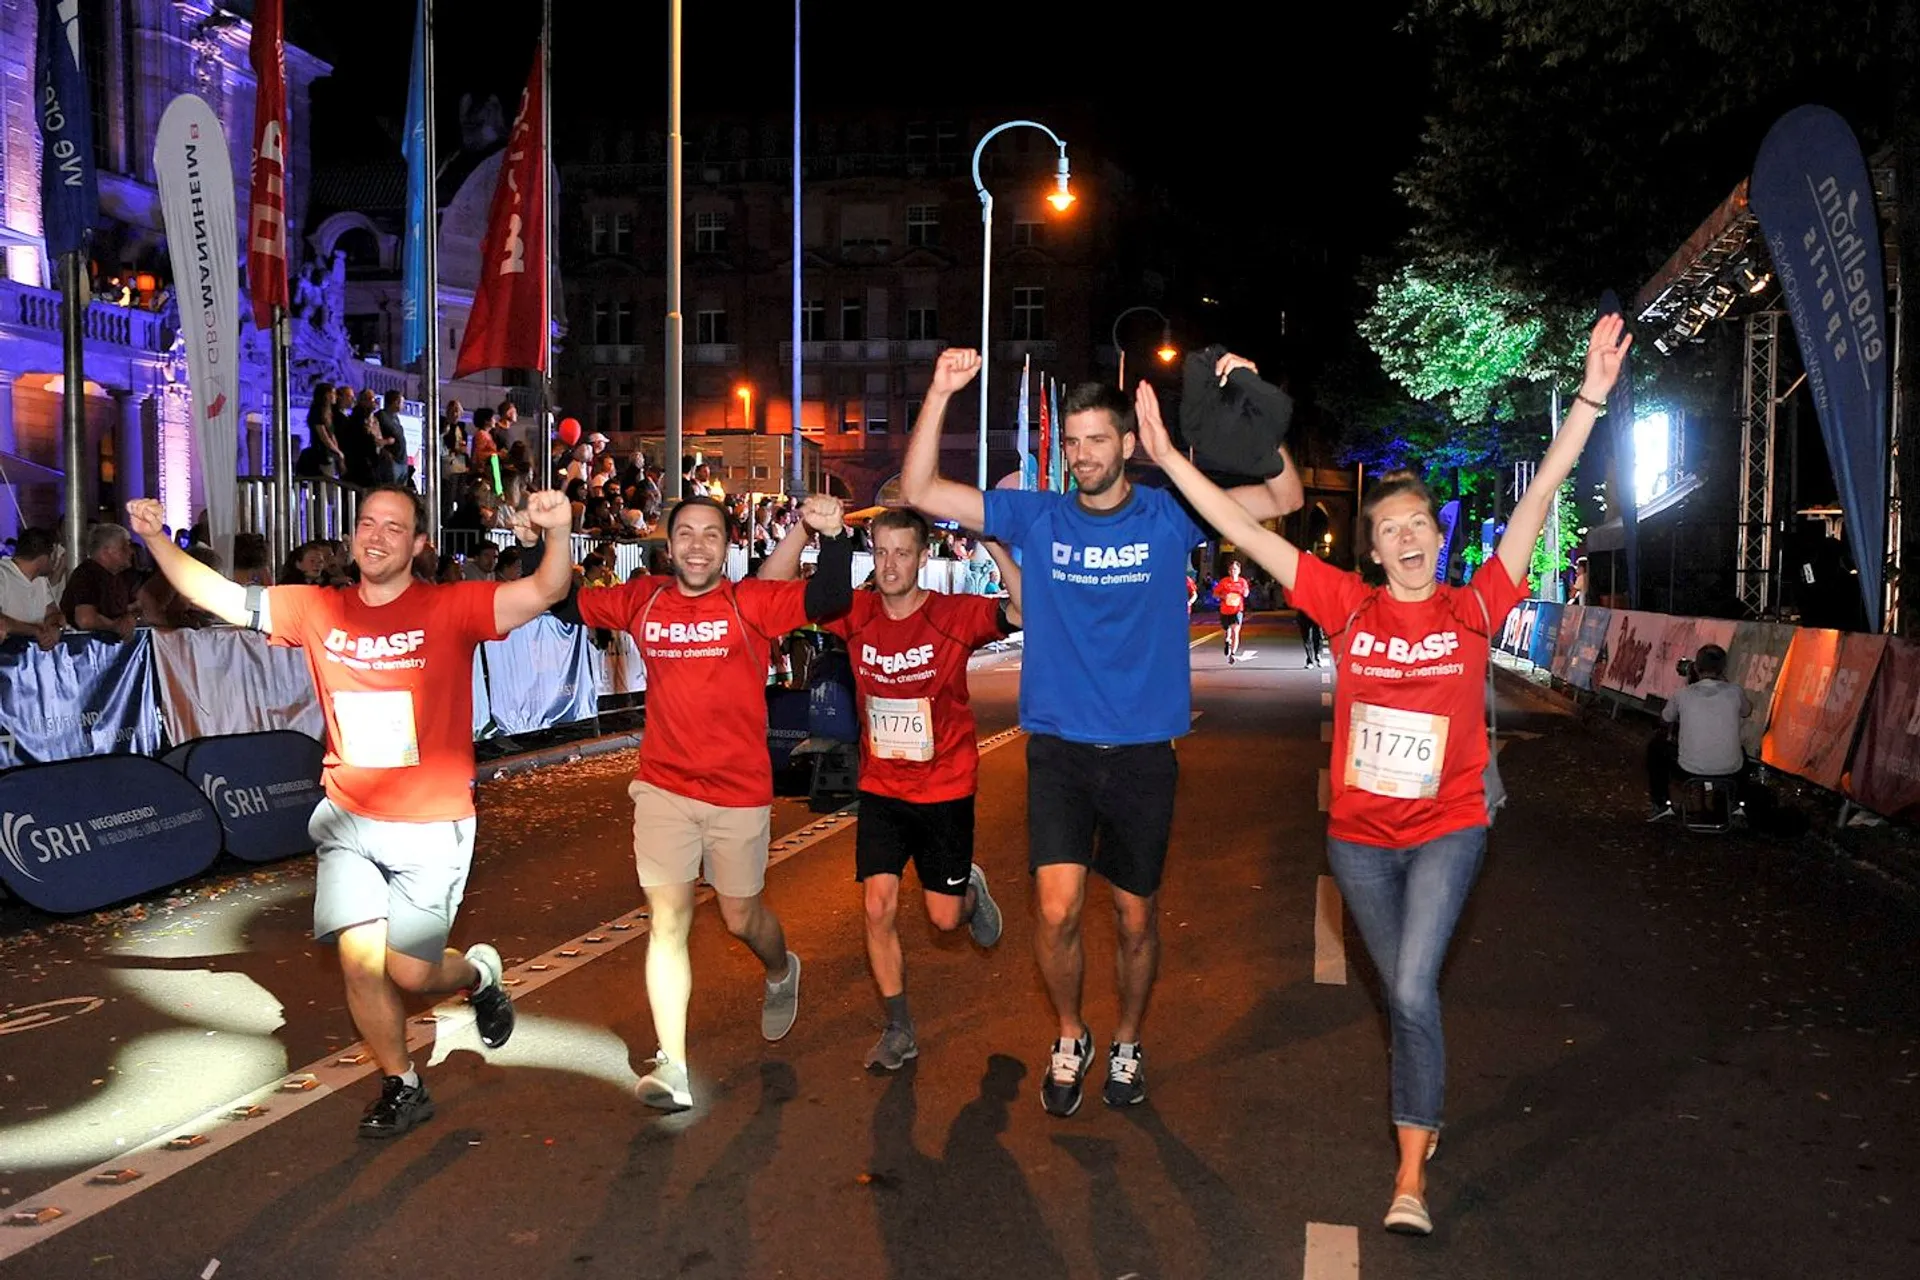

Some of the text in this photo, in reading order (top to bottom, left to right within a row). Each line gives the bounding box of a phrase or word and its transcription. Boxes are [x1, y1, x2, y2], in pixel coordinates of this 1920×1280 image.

[1083, 543, 1149, 569] BASF
[1051, 568, 1151, 585] We create chemistry
[356, 629, 425, 659] BASF
[669, 620, 728, 643] BASF
[683, 646, 729, 658] chemistry
[882, 643, 935, 675] BASF
[1387, 631, 1459, 664] BASF
[872, 714, 923, 733] 11776
[1361, 727, 1433, 761] 11776
[224, 786, 270, 818] SRH
[88, 805, 158, 831] WEGWEISEND!
[30, 822, 91, 864] SRH
